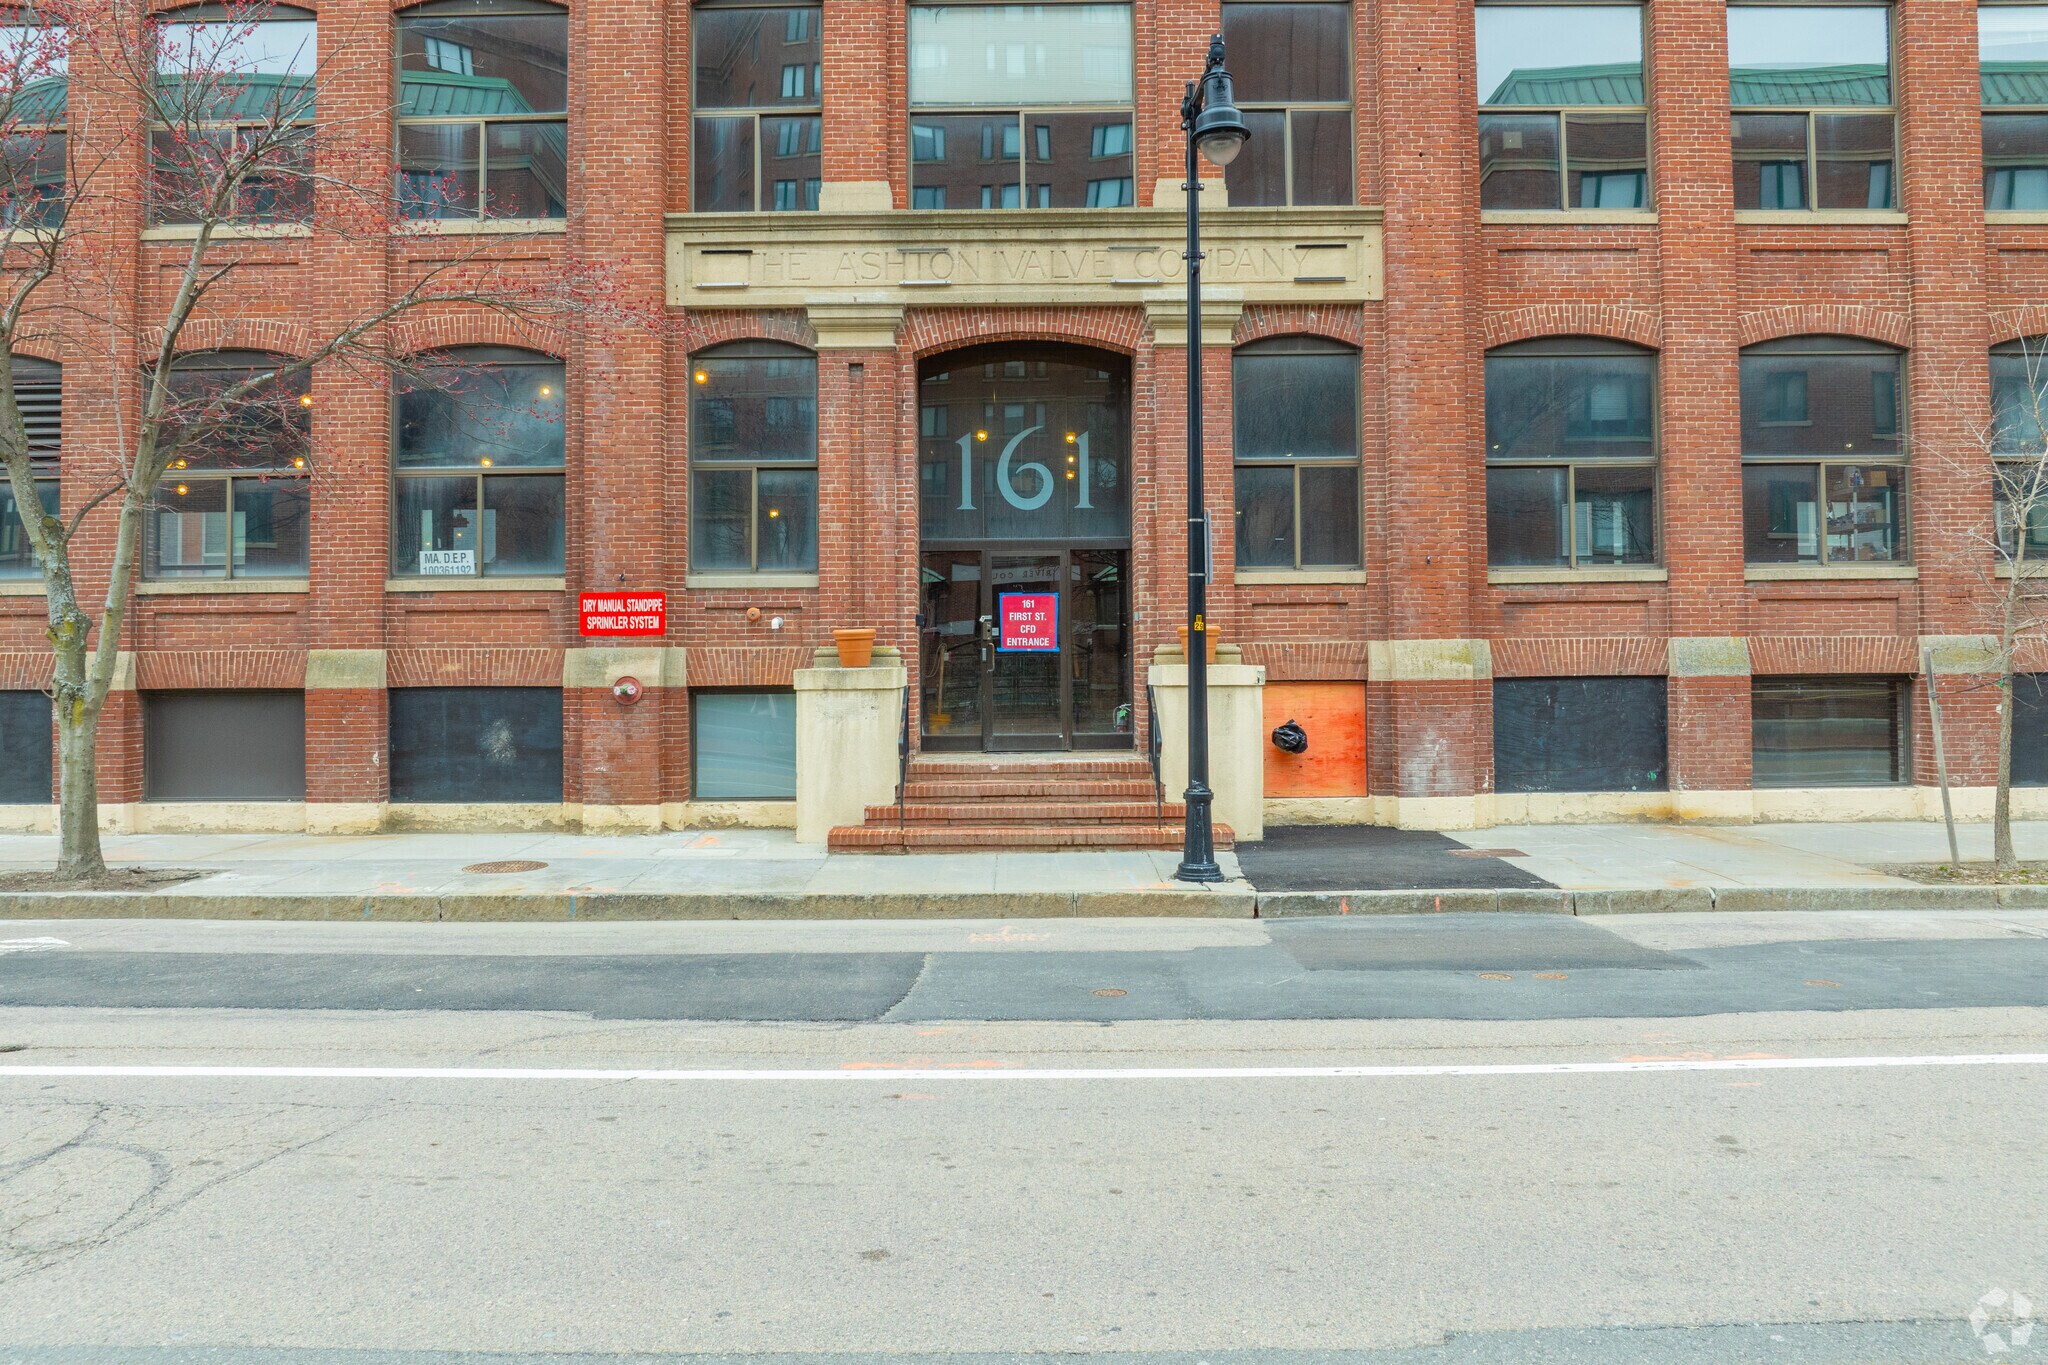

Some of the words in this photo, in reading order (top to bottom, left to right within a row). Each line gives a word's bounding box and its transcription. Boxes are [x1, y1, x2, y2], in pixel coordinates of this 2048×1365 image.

[738, 252, 811, 281] THE
[833, 251, 980, 280] ASHTON
[998, 250, 1114, 280] VALVE
[955, 425, 1095, 511] 161
[424, 553, 441, 564] MA.
[443, 552, 469, 564] D.E.P.
[582, 599, 597, 613] DRY
[597, 599, 626, 613] MANUAL
[626, 598, 663, 612] STANDPIPE
[1022, 599, 1035, 609] 161
[586, 615, 629, 630] SPRINKLER
[629, 615, 660, 629] SYSTEM
[1009, 612, 1033, 621] FIRST
[1034, 612, 1048, 621] ST.
[1020, 624, 1037, 634] CFD
[1006, 637, 1050, 647] ENTRANCE
